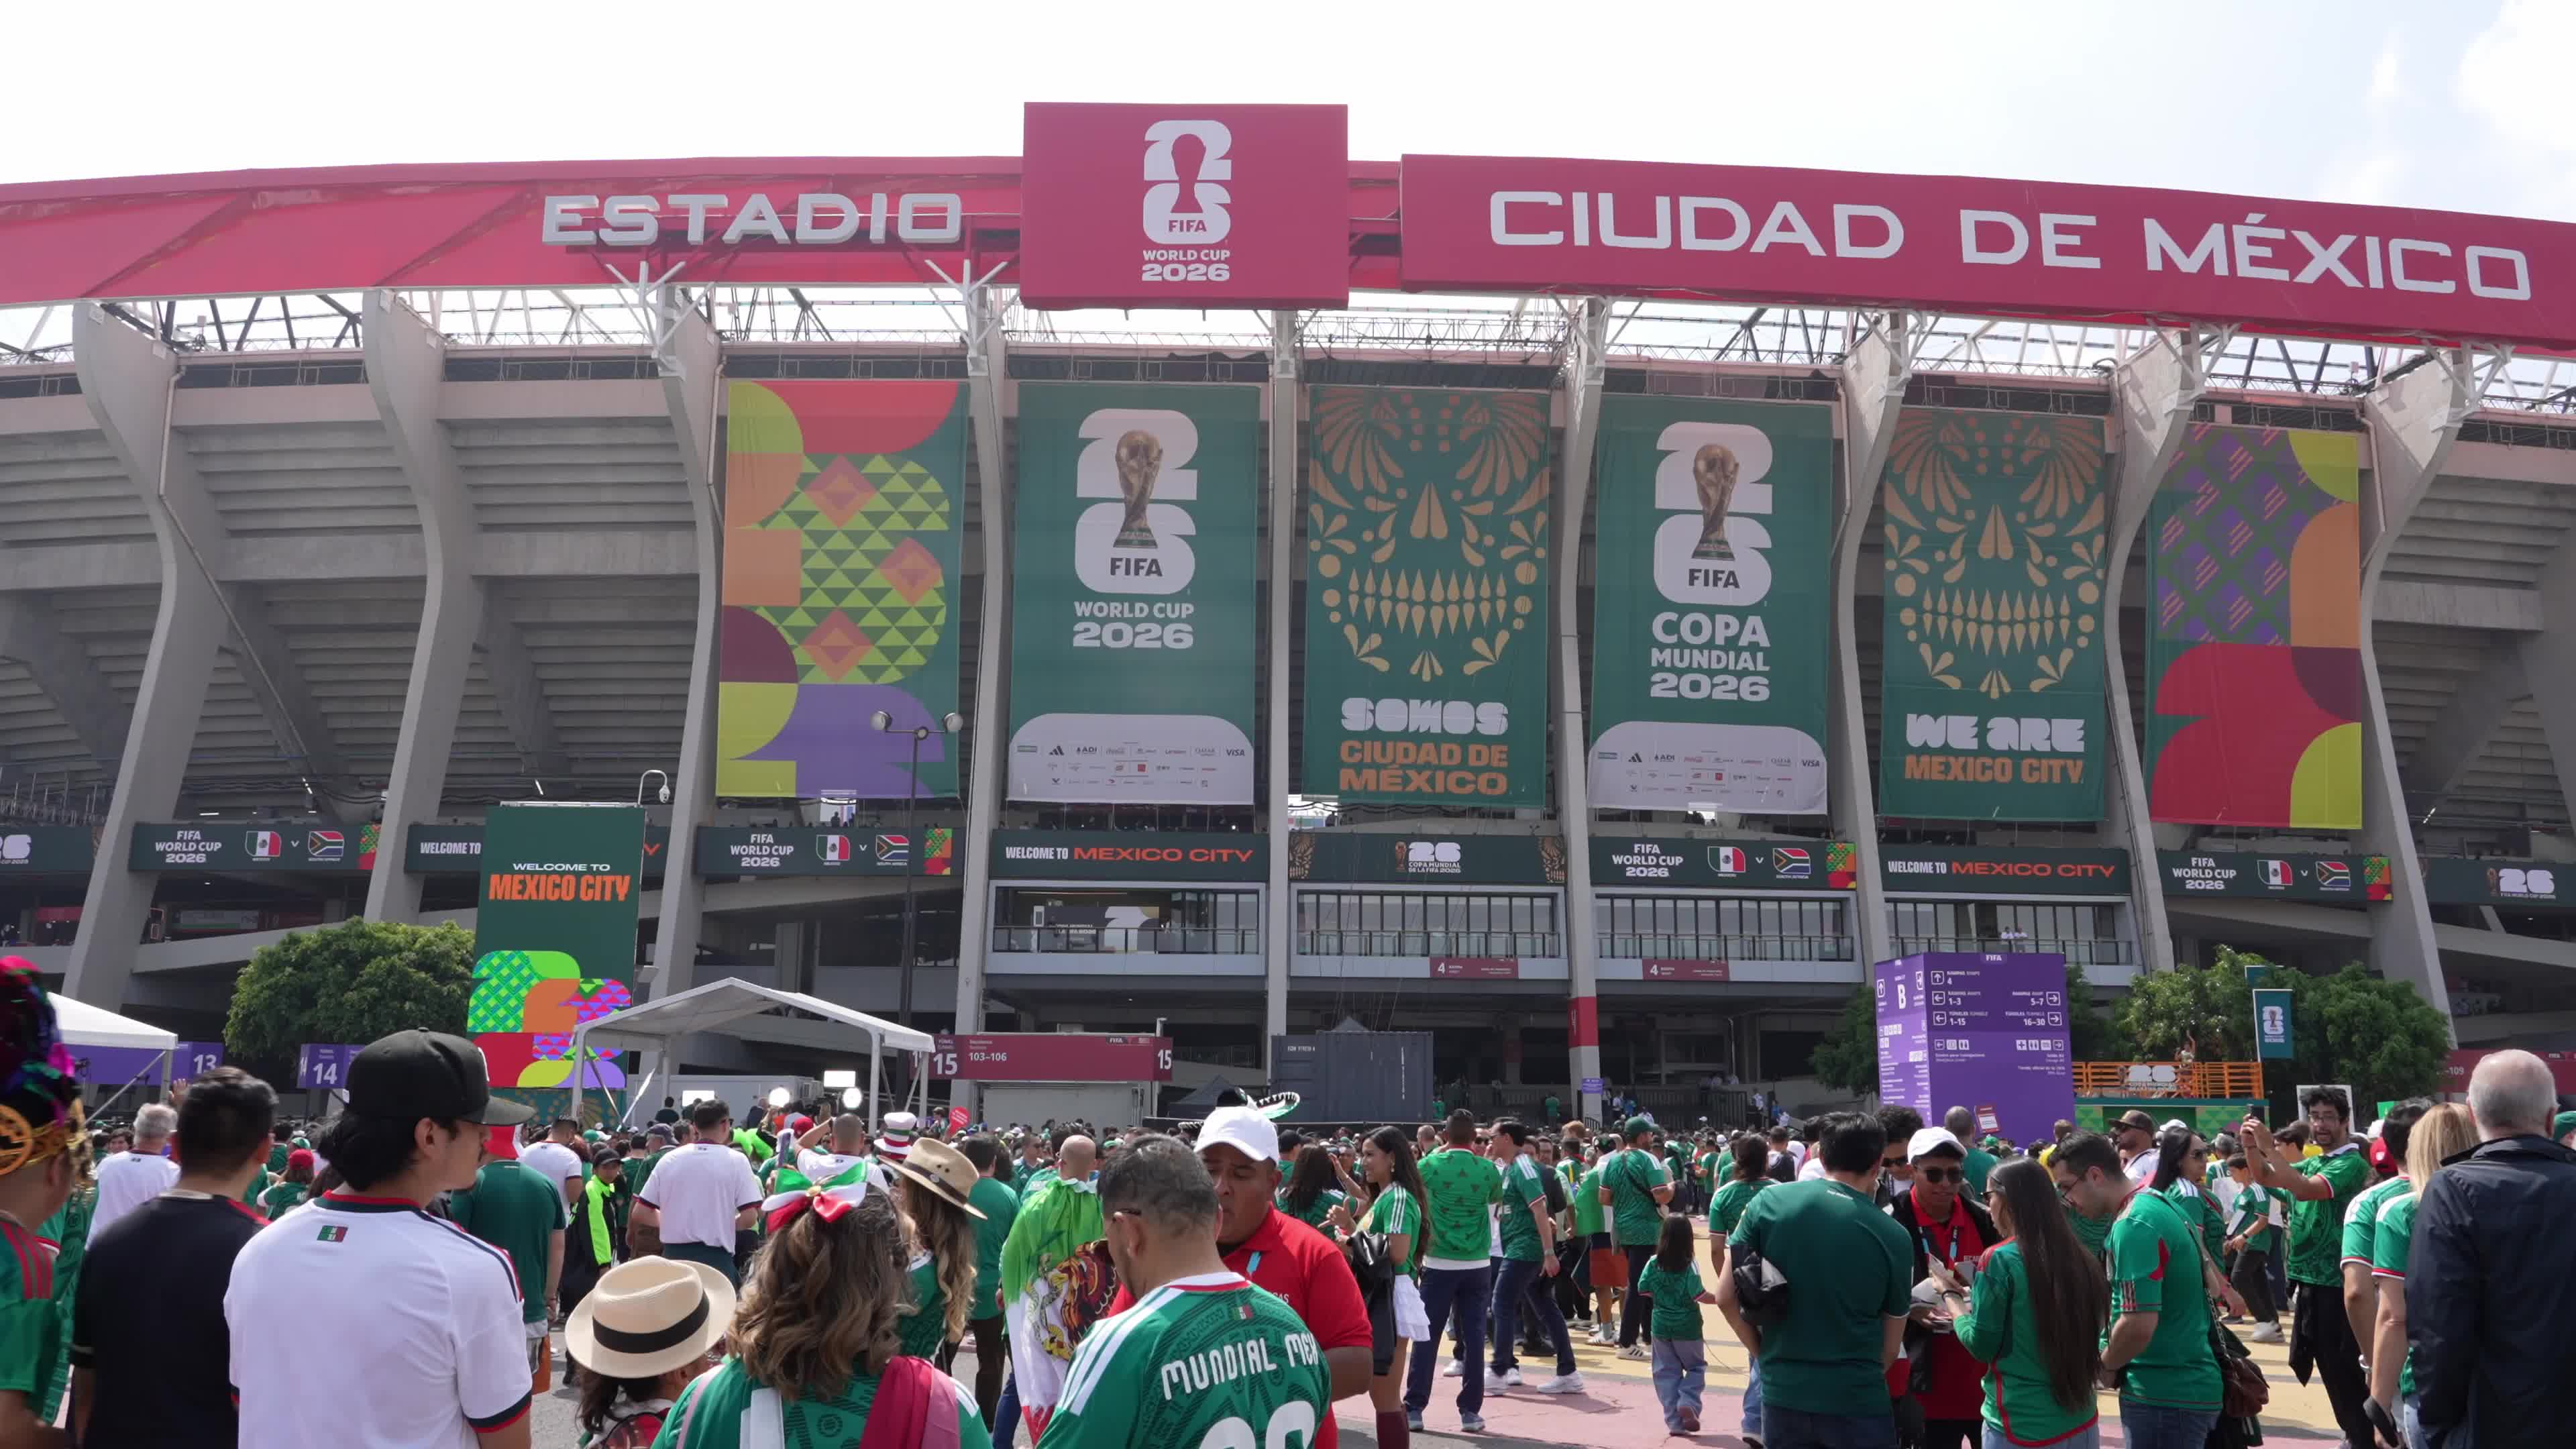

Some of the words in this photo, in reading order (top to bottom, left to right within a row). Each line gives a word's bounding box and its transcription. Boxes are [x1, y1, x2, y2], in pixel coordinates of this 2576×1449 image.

[542, 193, 962, 246] ESTADIO
[1169, 219, 1208, 232] FIFA
[1490, 191, 1904, 259] CIUDAD
[1960, 209, 2100, 269] DE
[2143, 213, 2530, 301] MÉXICO
[1142, 250, 1197, 261] WORLD
[1200, 250, 1230, 261] CUP
[1142, 264, 1230, 281] 2026
[1110, 557, 1163, 577] FIFA
[1688, 569, 1740, 589] FIFA
[1074, 601, 1149, 618] WORLD
[1153, 602, 1194, 619] CUP
[1073, 622, 1194, 649] 2026
[1652, 611, 1771, 647] COPA
[1650, 647, 1770, 672] MUNDIAL
[1650, 672, 1770, 702] 2026
[1341, 698, 1509, 735] SOMOS
[1906, 713, 1978, 749] WE
[1986, 716, 2085, 752] ARE
[1226, 749, 1246, 757] VISA
[1340, 740, 1462, 766] CIUDAD
[1467, 744, 1509, 767] DE
[1802, 759, 1820, 767] VISA
[1904, 755, 2012, 782] MEXICO
[2021, 759, 2084, 784] CITY
[1340, 765, 1508, 795] MÉXICO
[177, 830, 201, 840] FIFA
[750, 834, 773, 844] FIFA
[155, 842, 197, 851] WORLD
[198, 842, 222, 851] CUP
[420, 842, 468, 854] WELCOME
[469, 842, 482, 854] TO
[731, 845, 771, 855] WORLD
[771, 845, 794, 855] CUP
[1006, 846, 1055, 859] WELCOME
[1056, 847, 1069, 859] TO
[1073, 847, 1183, 861] MEXICO
[1189, 849, 1254, 862] CITY
[1634, 844, 1660, 854] FIFA
[166, 853, 207, 863] 2026
[741, 857, 780, 867] 2026
[1613, 855, 1658, 865] WORLD
[1659, 856, 1683, 866] CUP
[2191, 857, 2215, 867] FIFA
[513, 863, 588, 872] WELCOME
[590, 863, 610, 872] TO
[1625, 867, 1669, 877] 2026
[1888, 861, 1934, 873] WELCOME
[1935, 861, 1947, 873] TO
[1952, 862, 2052, 876] MEXICO
[2057, 863, 2115, 877] CITY
[2172, 867, 2214, 878] WORLD
[2215, 869, 2237, 879] CUP
[488, 874, 576, 901] MEXICO
[580, 875, 631, 902] CITY
[2185, 880, 2224, 890] 2026
[1438, 962, 1445, 973] 4
[1650, 964, 1658, 975] 4
[1947, 977, 1953, 985] 4
[1897, 984, 1907, 1009] B
[193, 1054, 217, 1073] 13
[933, 1053, 958, 1075] 15
[1157, 1049, 1173, 1069] 15
[313, 1063, 337, 1084] 14
[1161, 1338, 1277, 1401] MUNDIAL
